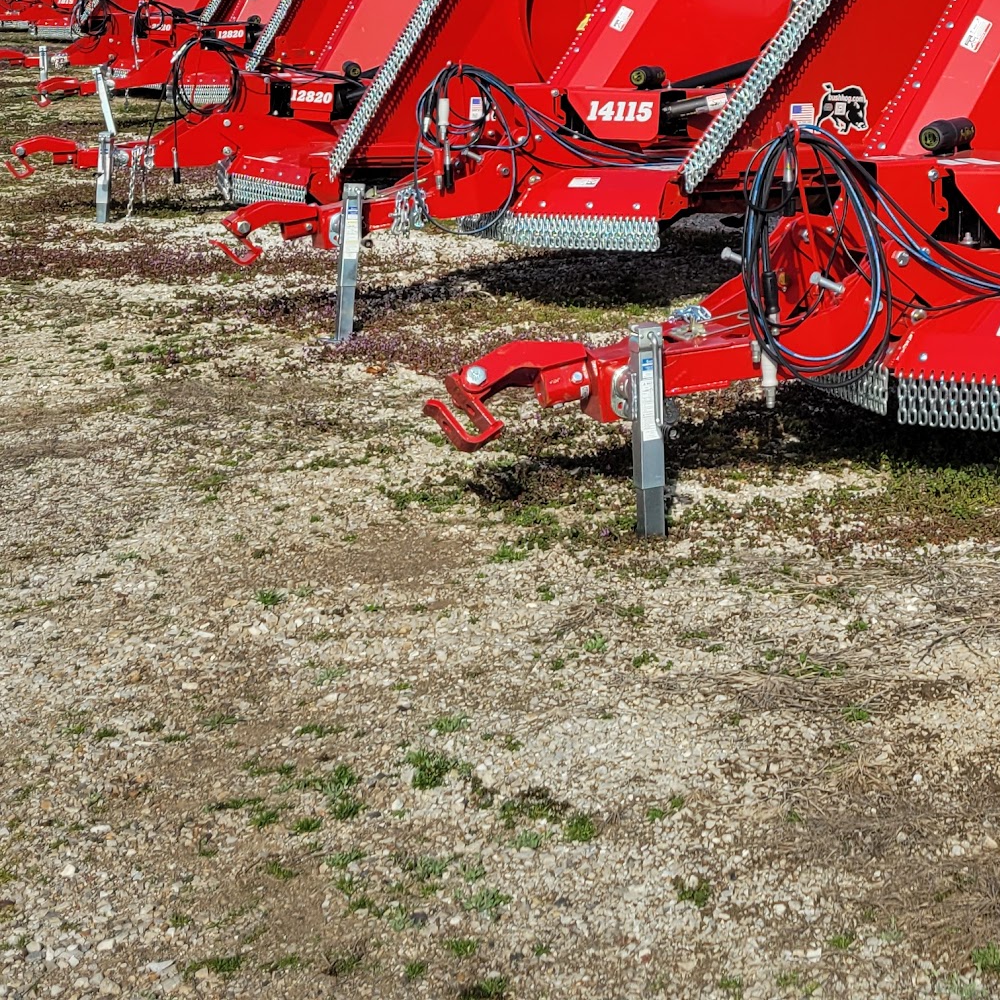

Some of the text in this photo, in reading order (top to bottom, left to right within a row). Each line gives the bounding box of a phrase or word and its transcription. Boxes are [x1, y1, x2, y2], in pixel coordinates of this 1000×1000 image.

[217, 29, 245, 39] 12820
[290, 89, 333, 104] 12820
[827, 94, 865, 104] bushhog.com
[586, 100, 654, 123] 14115
